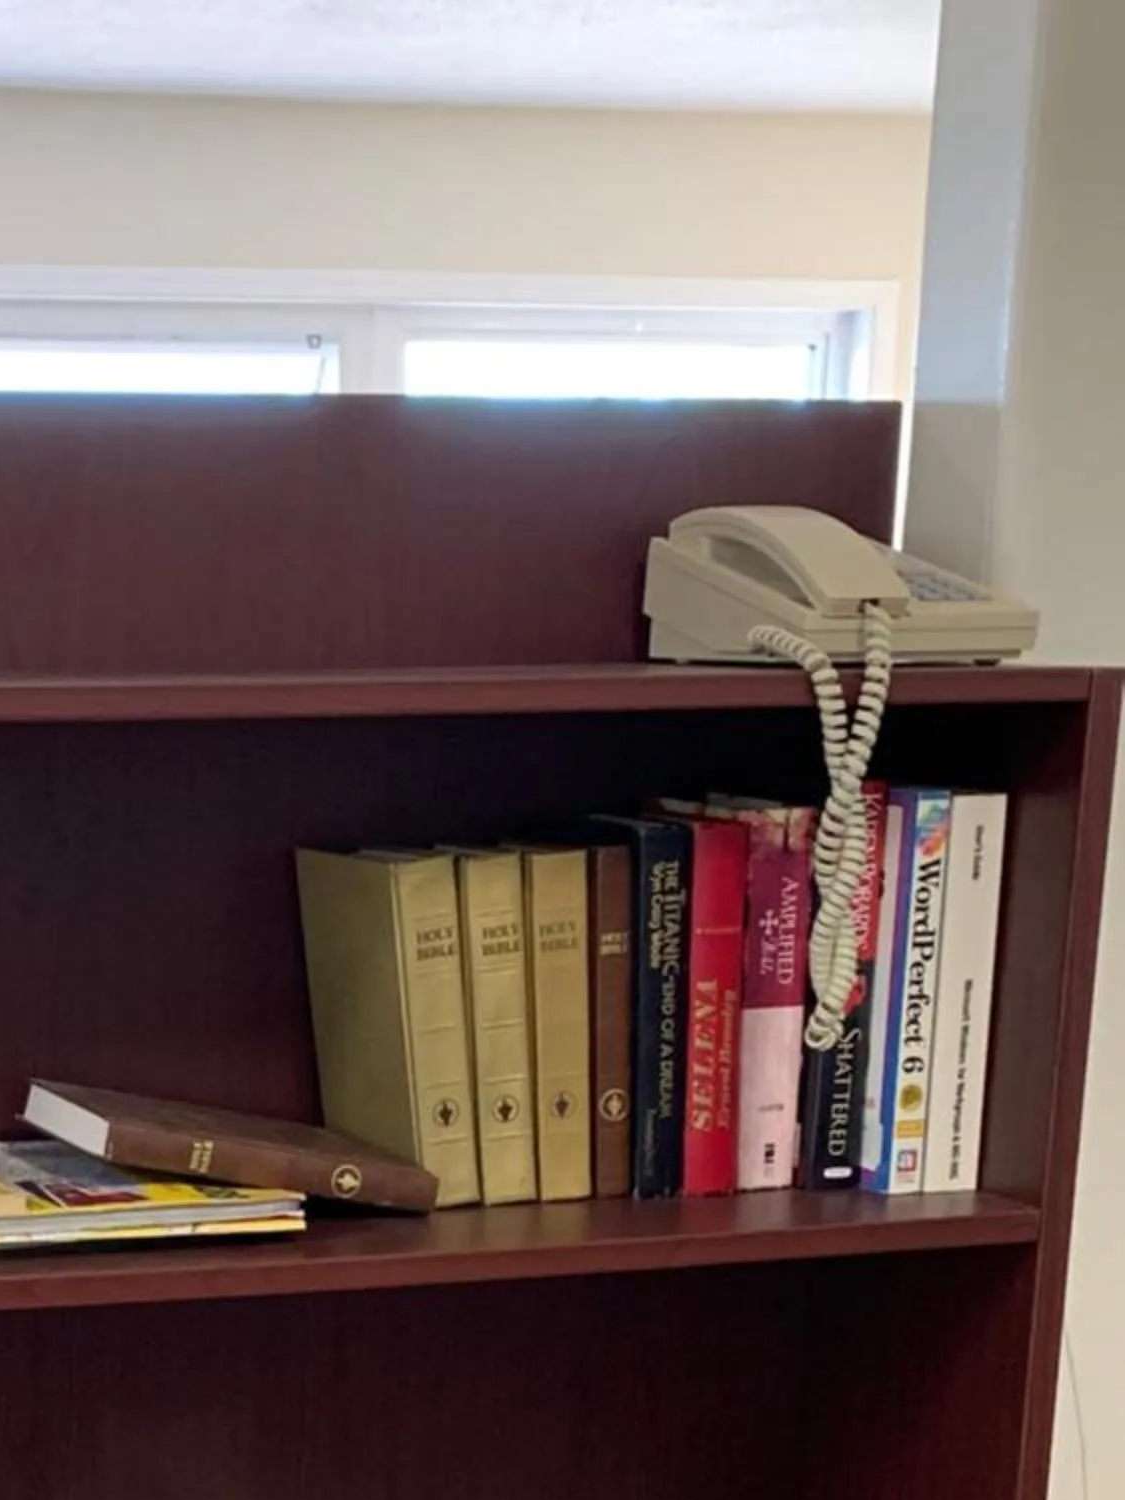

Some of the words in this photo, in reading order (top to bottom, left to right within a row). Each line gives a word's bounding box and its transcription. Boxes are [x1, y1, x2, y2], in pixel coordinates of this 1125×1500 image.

[416, 927, 453, 944] HOLY
[482, 922, 518, 939] HOLY
[538, 920, 577, 937] HOLY
[777, 876, 800, 985] AMPLIFIED
[904, 857, 942, 1047] WordPerfect
[659, 1042, 675, 1058] A
[691, 980, 718, 1132] SELENA
[902, 1056, 924, 1074] 6
[827, 1028, 862, 1157] SHATTERED
